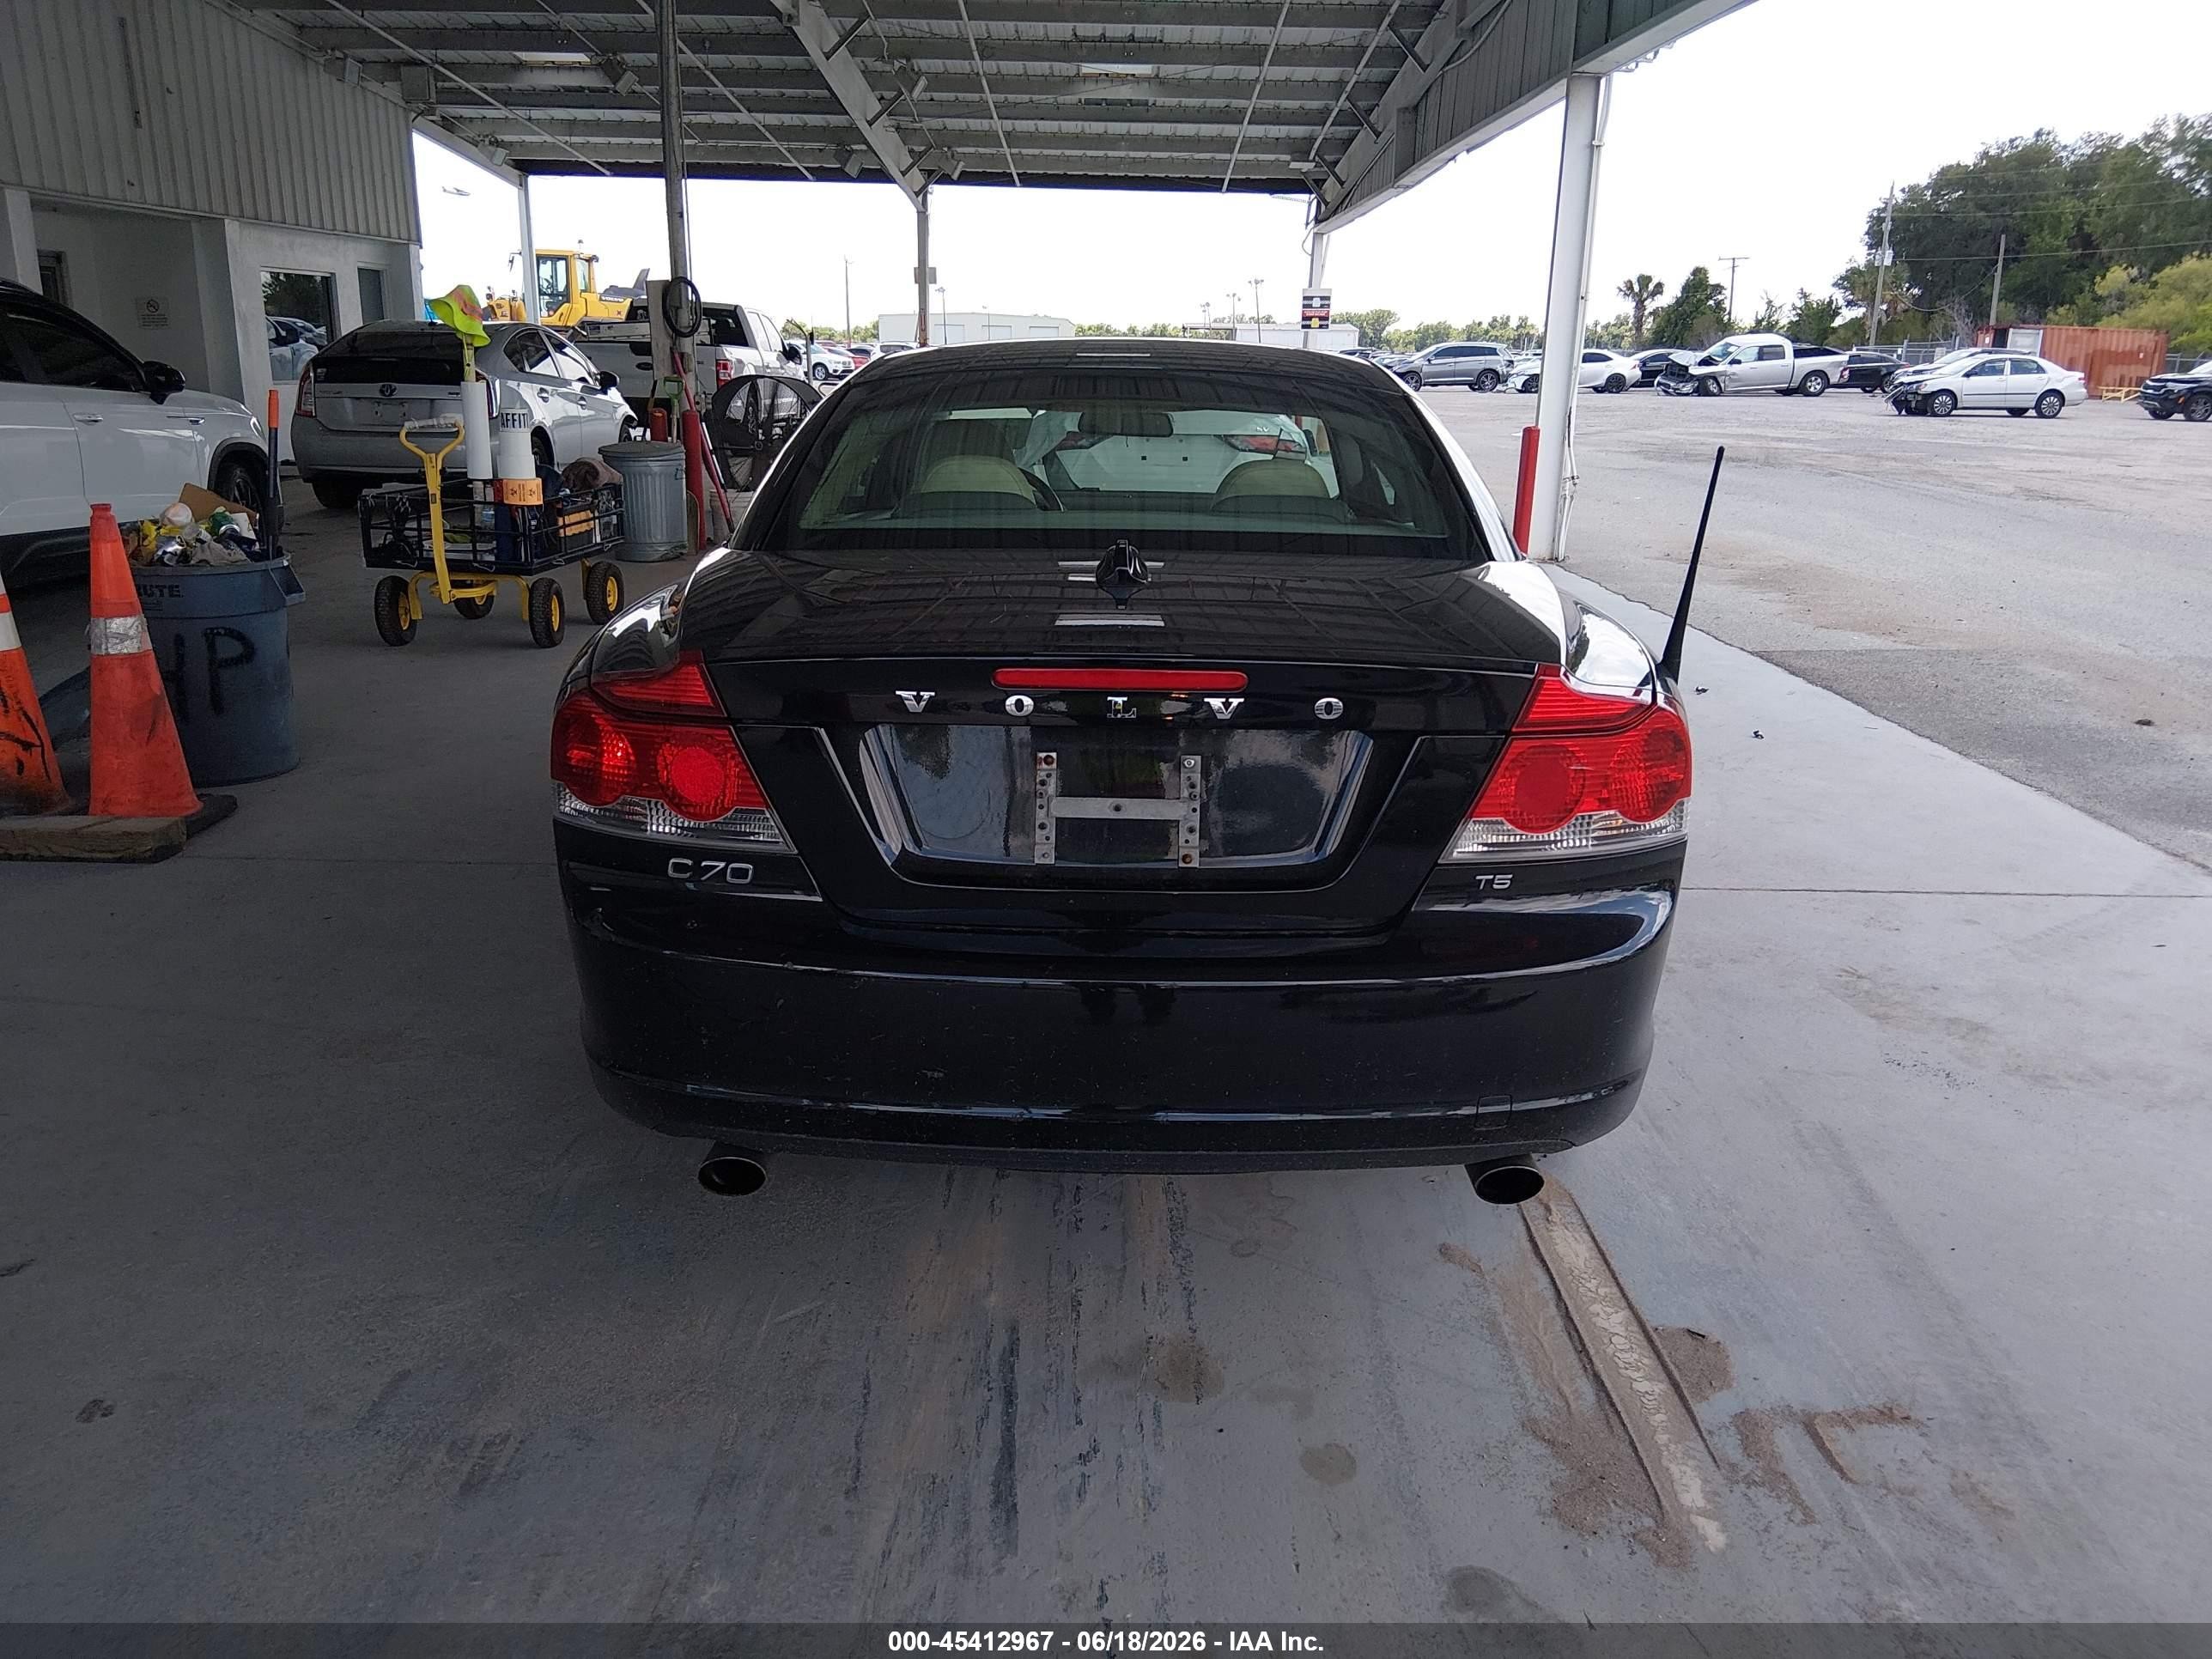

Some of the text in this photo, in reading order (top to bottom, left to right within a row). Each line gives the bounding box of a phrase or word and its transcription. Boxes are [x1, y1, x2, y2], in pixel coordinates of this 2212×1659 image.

[896, 690, 1344, 720] VOLVO
[668, 858, 753, 884] C70
[1475, 874, 1513, 890] T5
